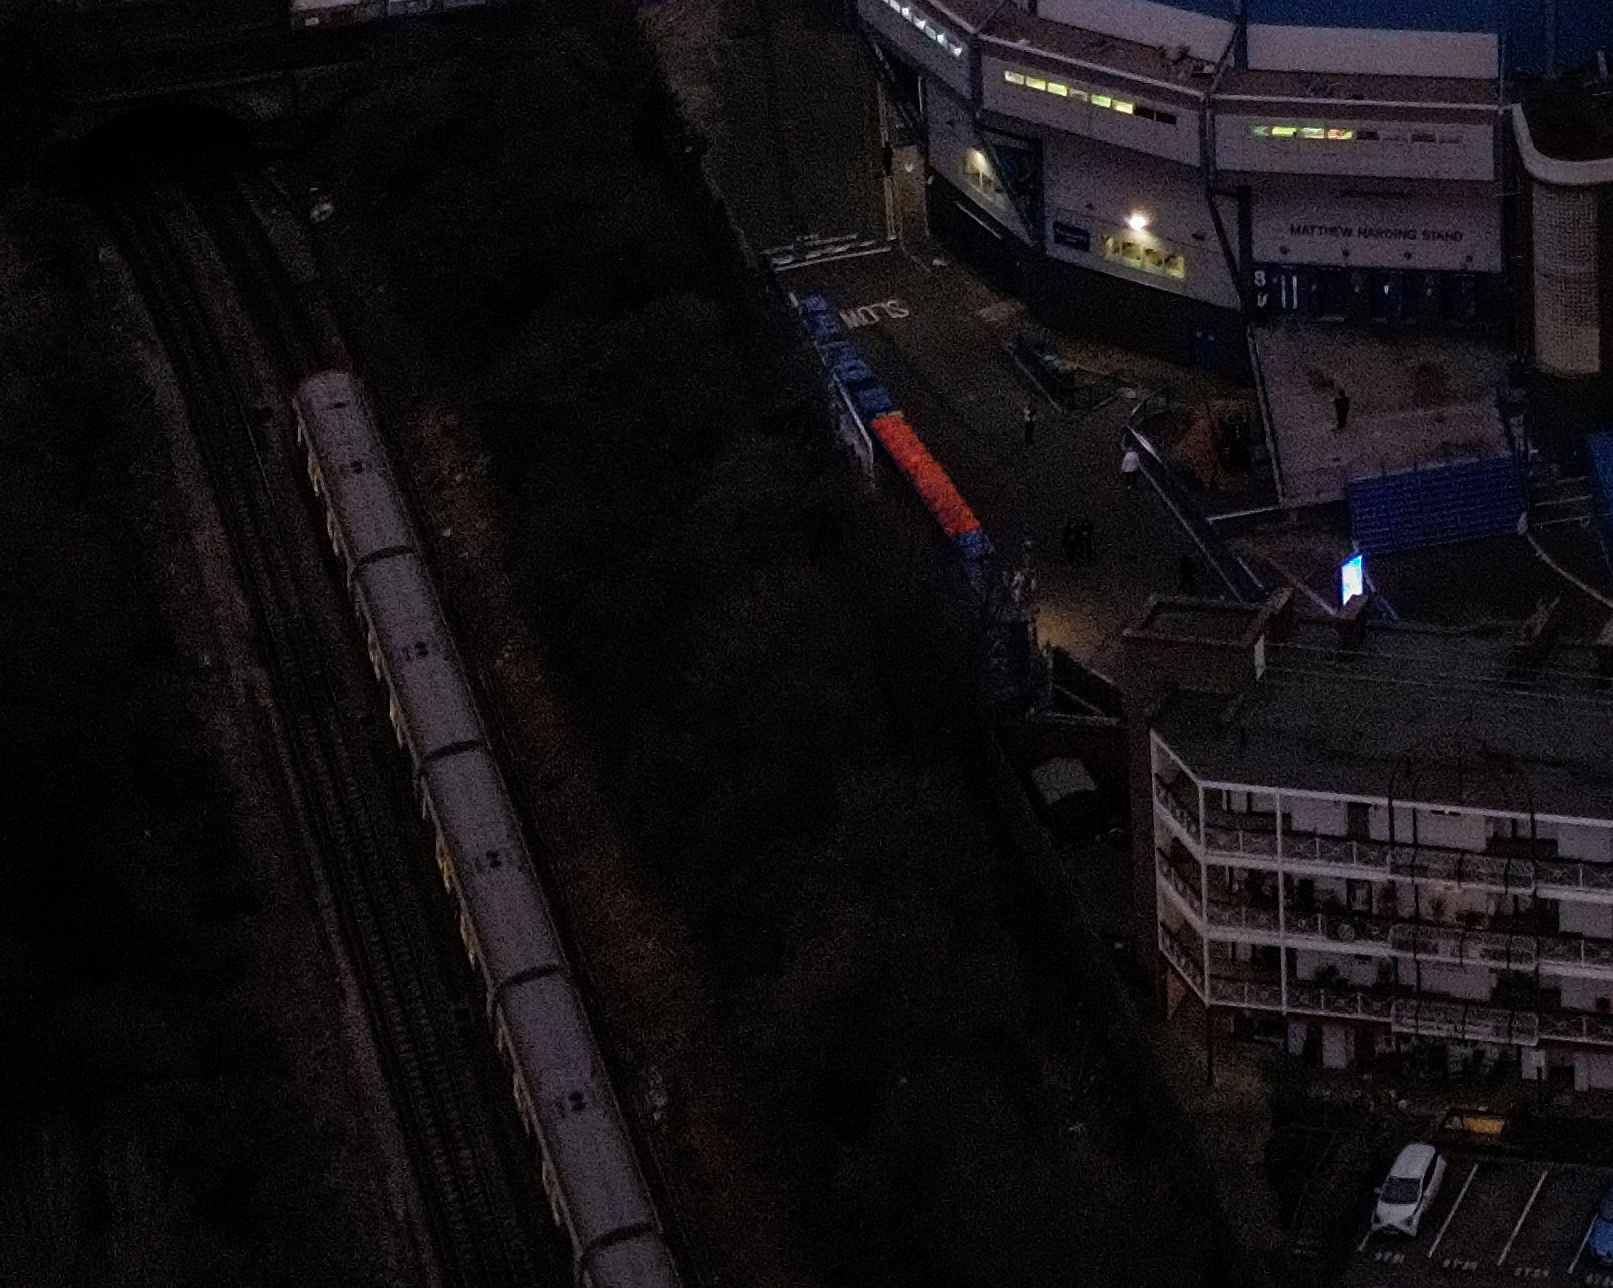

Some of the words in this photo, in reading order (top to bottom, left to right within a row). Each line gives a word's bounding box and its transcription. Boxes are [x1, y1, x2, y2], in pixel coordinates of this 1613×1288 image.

[1290, 224, 1353, 239] MATTHEW
[1357, 226, 1417, 241] HARDING
[1422, 229, 1464, 243] STAND
[838, 299, 910, 330] SLOW
